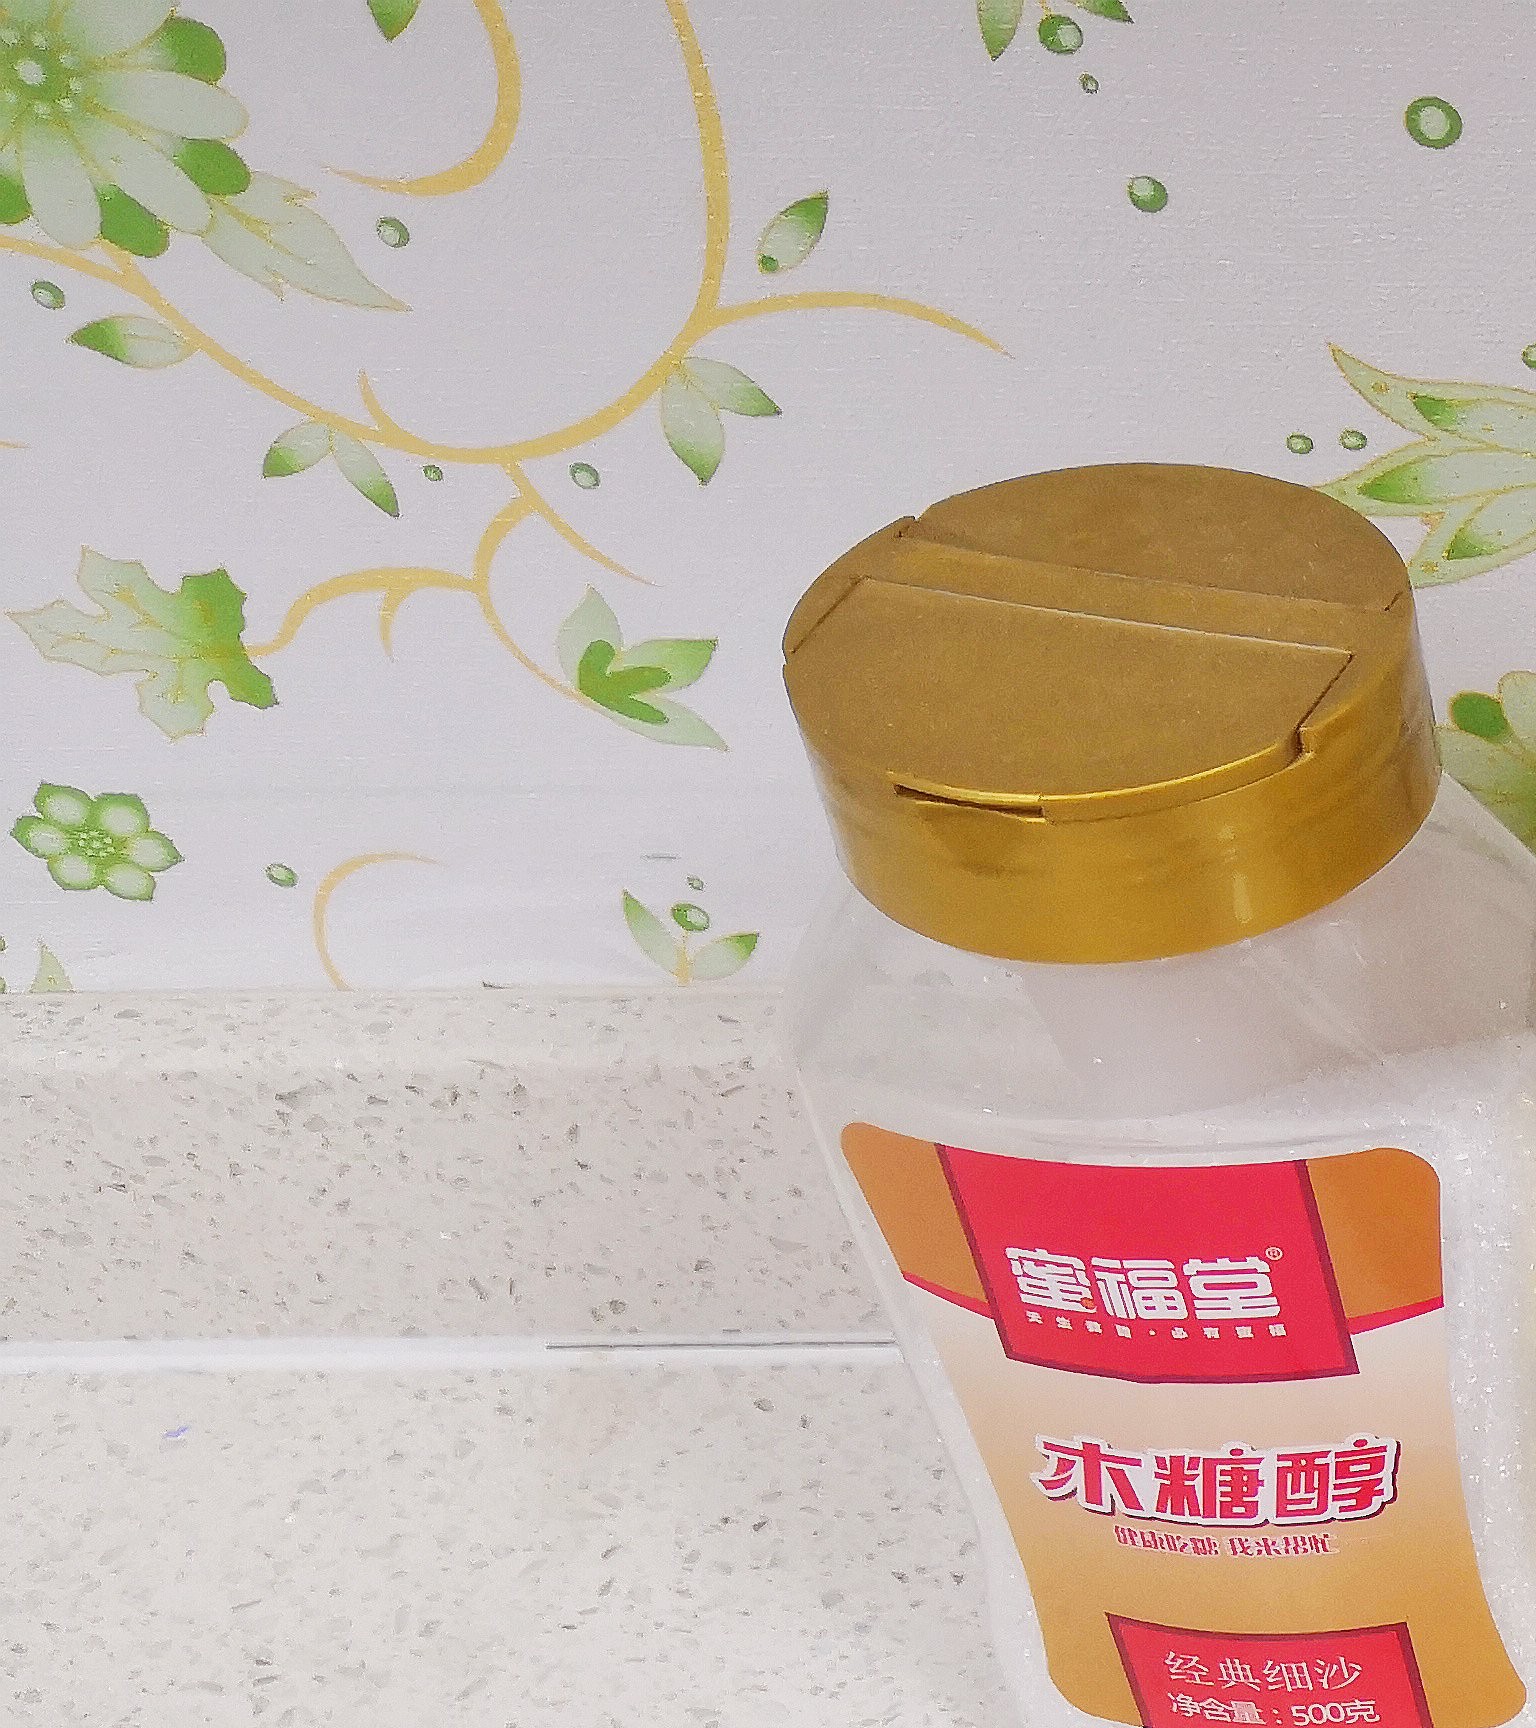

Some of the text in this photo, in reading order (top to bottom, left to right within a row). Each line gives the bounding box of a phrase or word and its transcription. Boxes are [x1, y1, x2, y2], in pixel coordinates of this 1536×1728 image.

[1035, 1436, 1391, 1522] 木糖醇
[1164, 1650, 1363, 1692] 经典细沙
